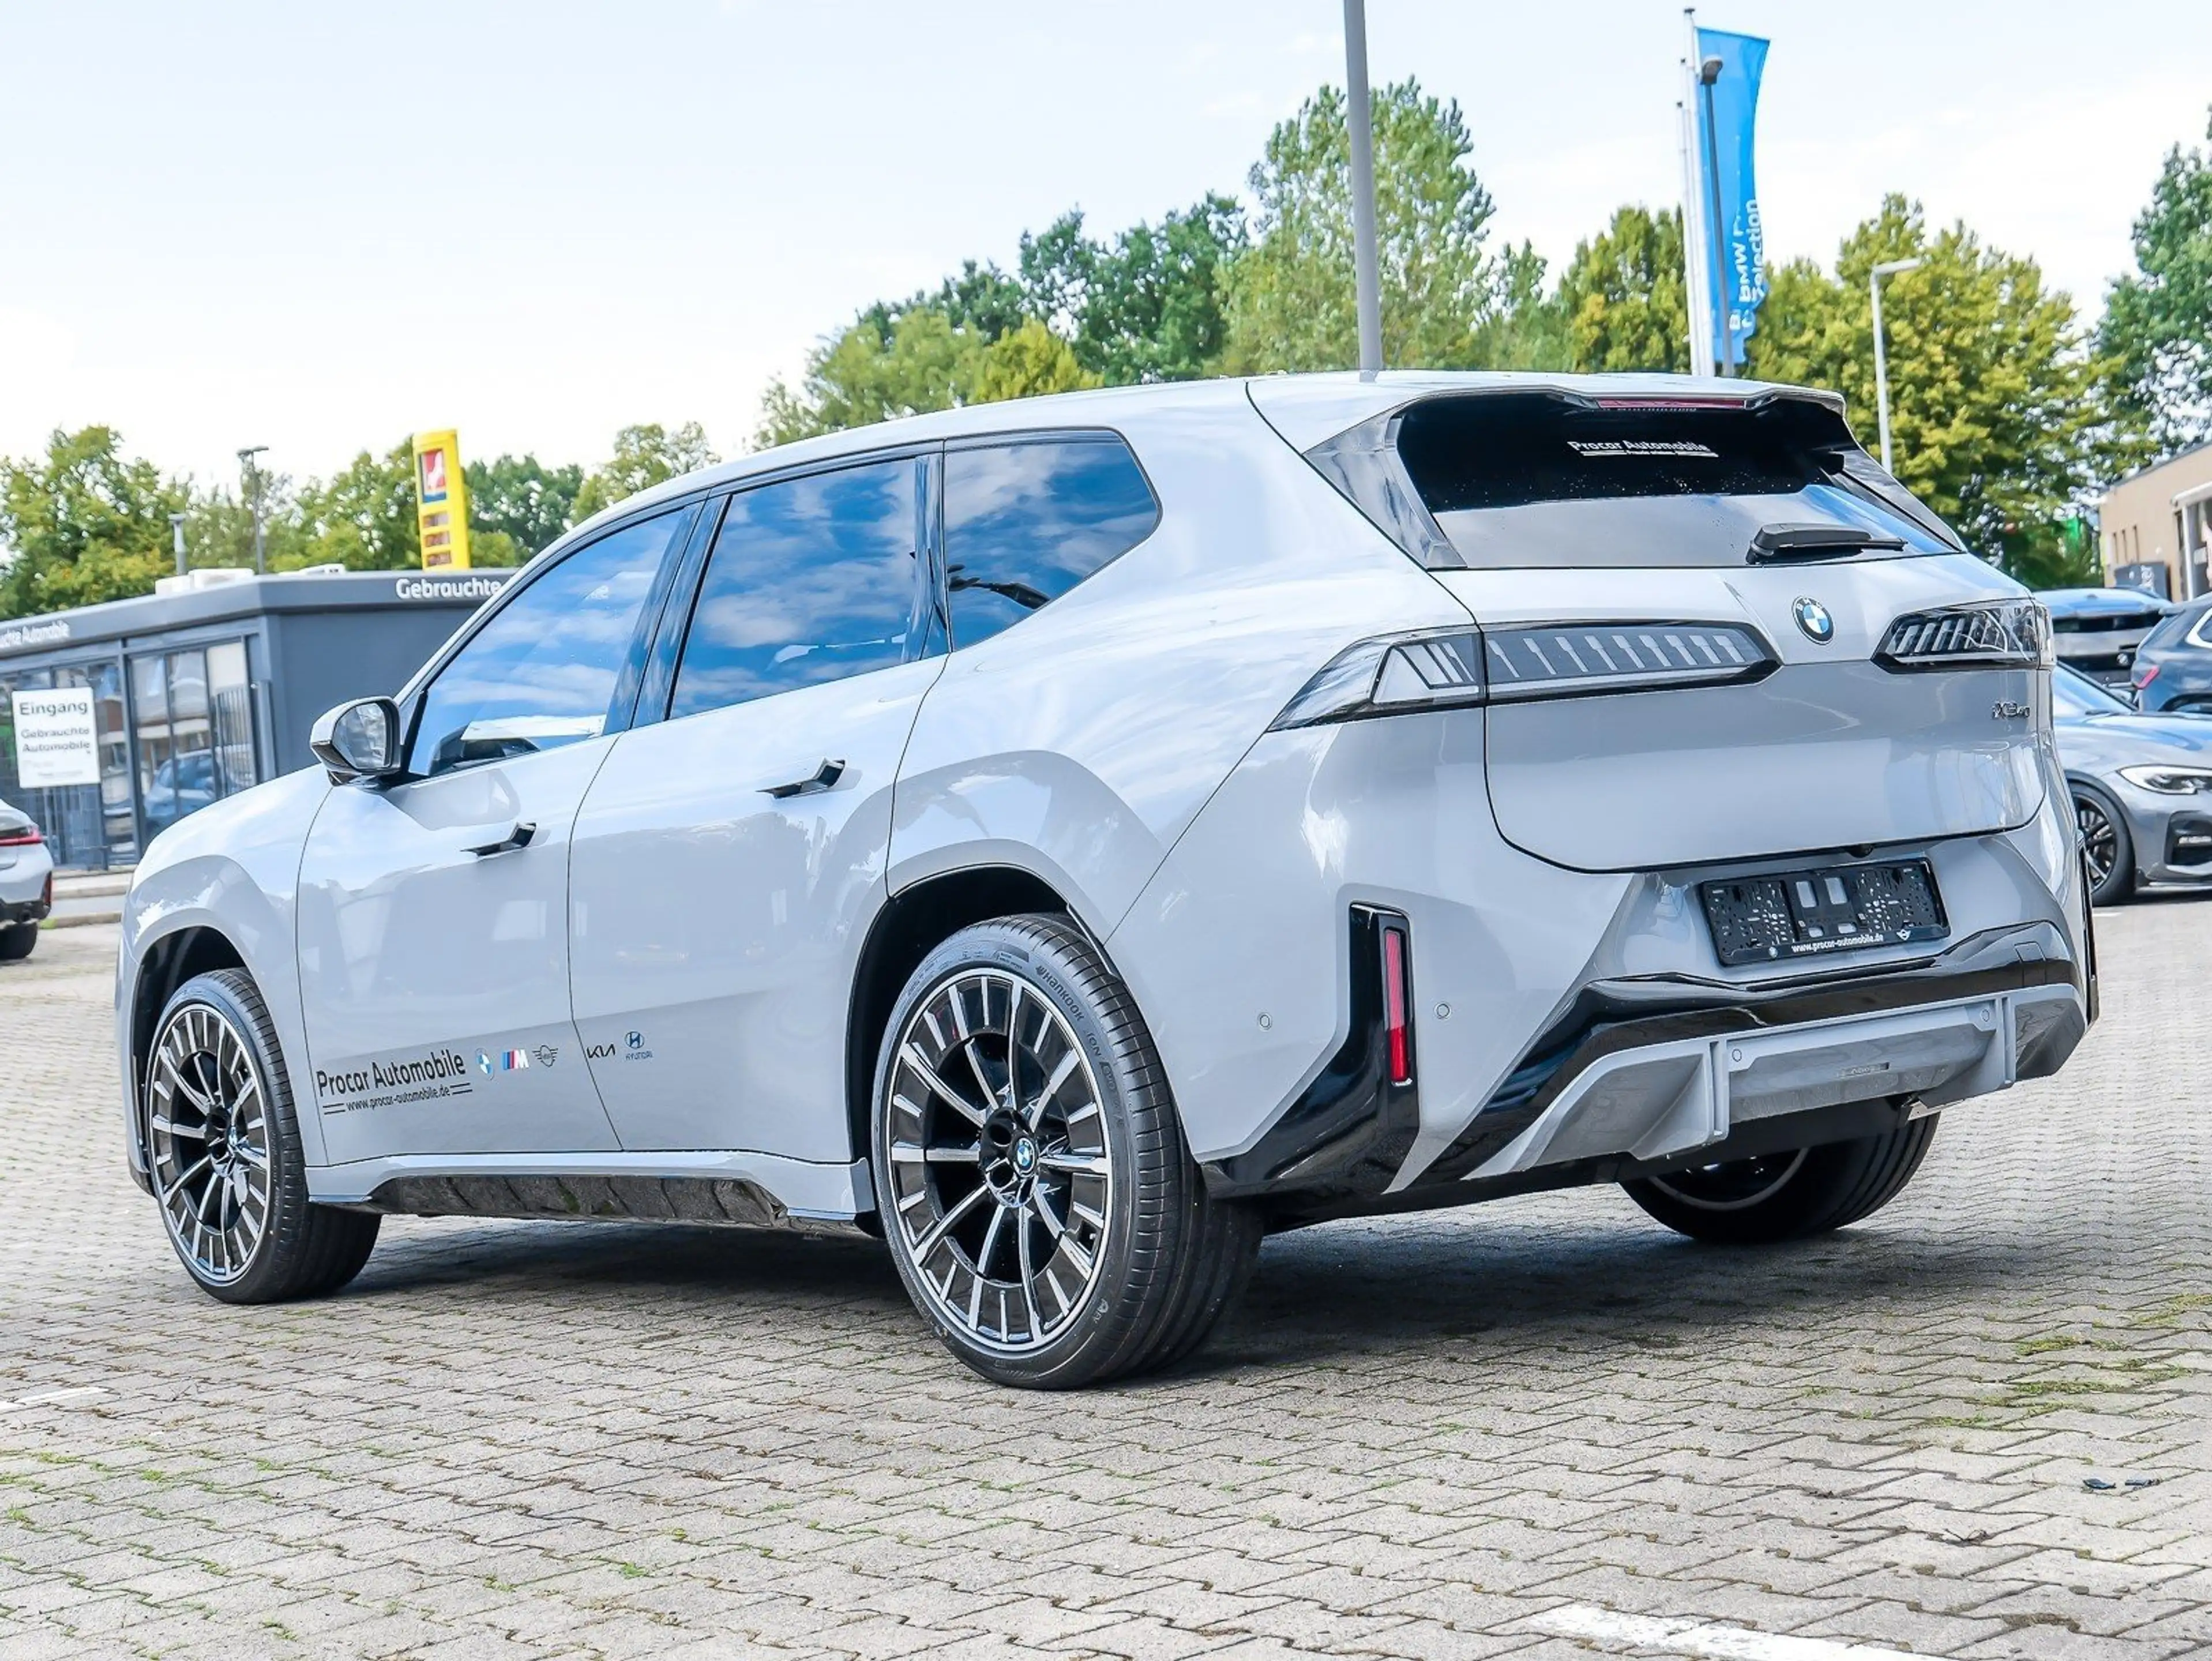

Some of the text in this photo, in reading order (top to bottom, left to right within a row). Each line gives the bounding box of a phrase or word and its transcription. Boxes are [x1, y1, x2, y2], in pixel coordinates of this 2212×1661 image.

[1731, 242, 1752, 303] BMW
[1567, 441, 1622, 450] Procar
[396, 577, 502, 599] Gebrauchte
[20, 702, 88, 716] Eingang
[21, 728, 89, 738] Gebrauchte
[22, 741, 91, 752] Automobile
[316, 1049, 466, 1097] Procar Automobile
[346, 1084, 450, 1111] www.procar-automobile.de
